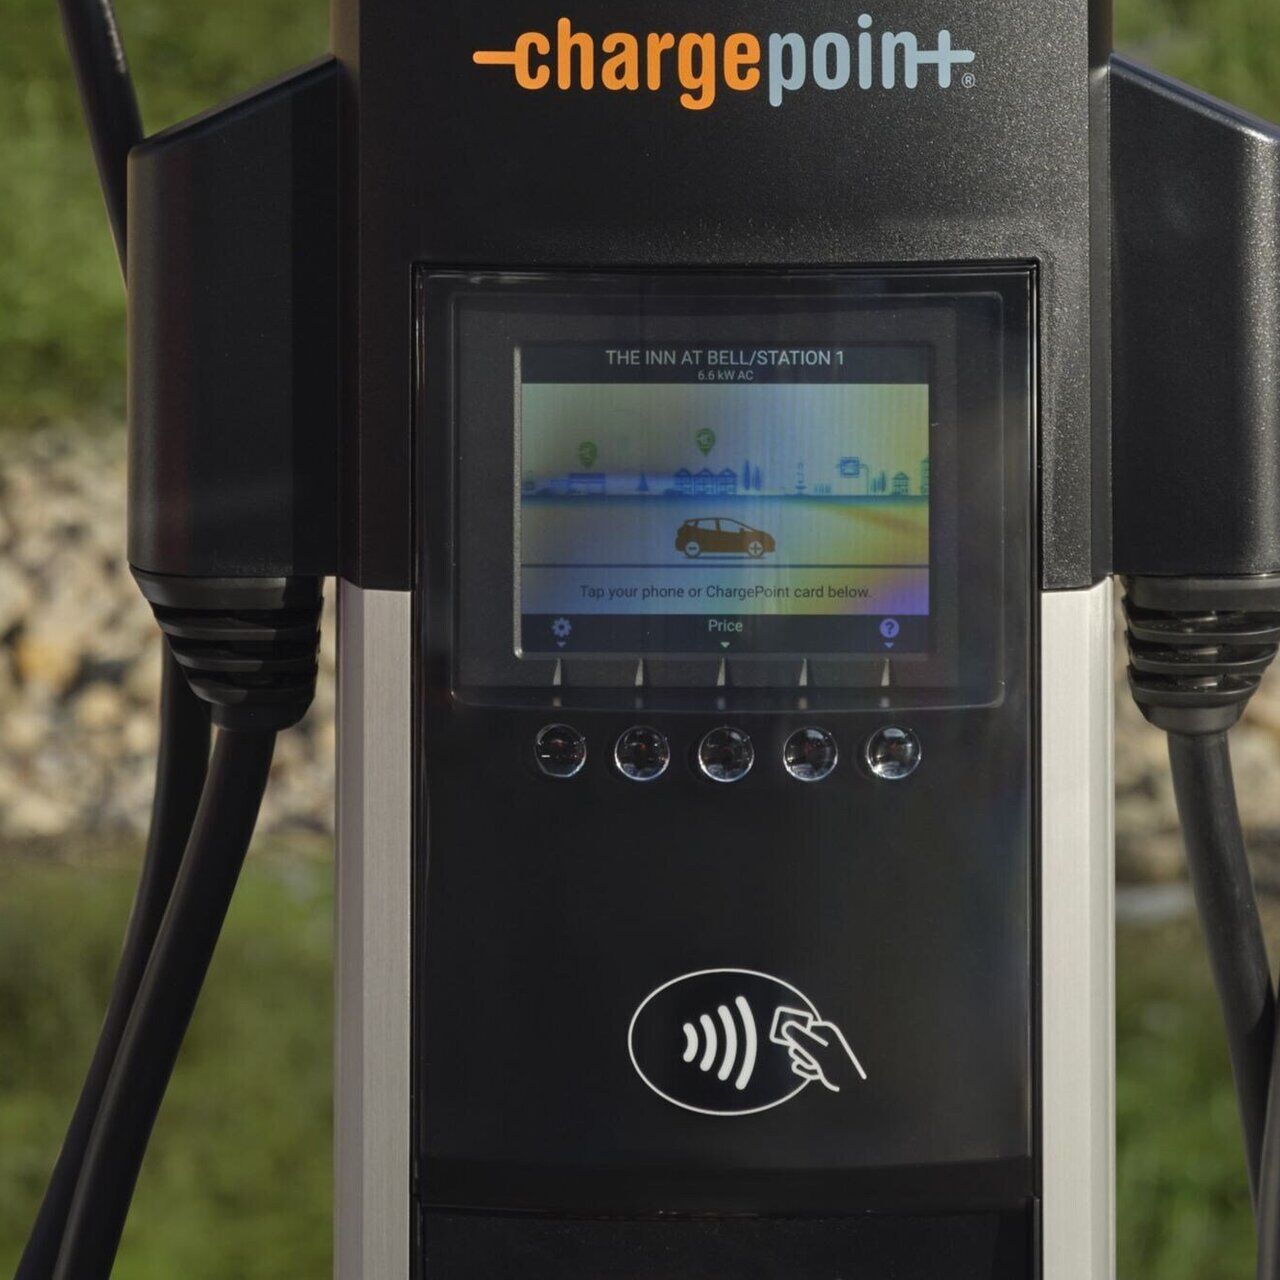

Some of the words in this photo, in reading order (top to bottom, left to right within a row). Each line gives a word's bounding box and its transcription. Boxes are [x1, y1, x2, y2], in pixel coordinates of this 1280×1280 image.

[605, 350, 640, 365] THE
[645, 350, 676, 365] INN
[681, 350, 702, 365] AT
[707, 350, 831, 366] BELL/STATION
[835, 350, 844, 365] 1
[697, 370, 715, 381] 6.6
[718, 370, 736, 381] kW
[737, 370, 754, 381] AC
[580, 585, 605, 600] Tap
[607, 588, 638, 600] your
[642, 585, 685, 600] phone
[688, 587, 703, 598] or
[706, 585, 790, 601] ChargePoint
[794, 585, 824, 598] card
[708, 619, 743, 632] Price
